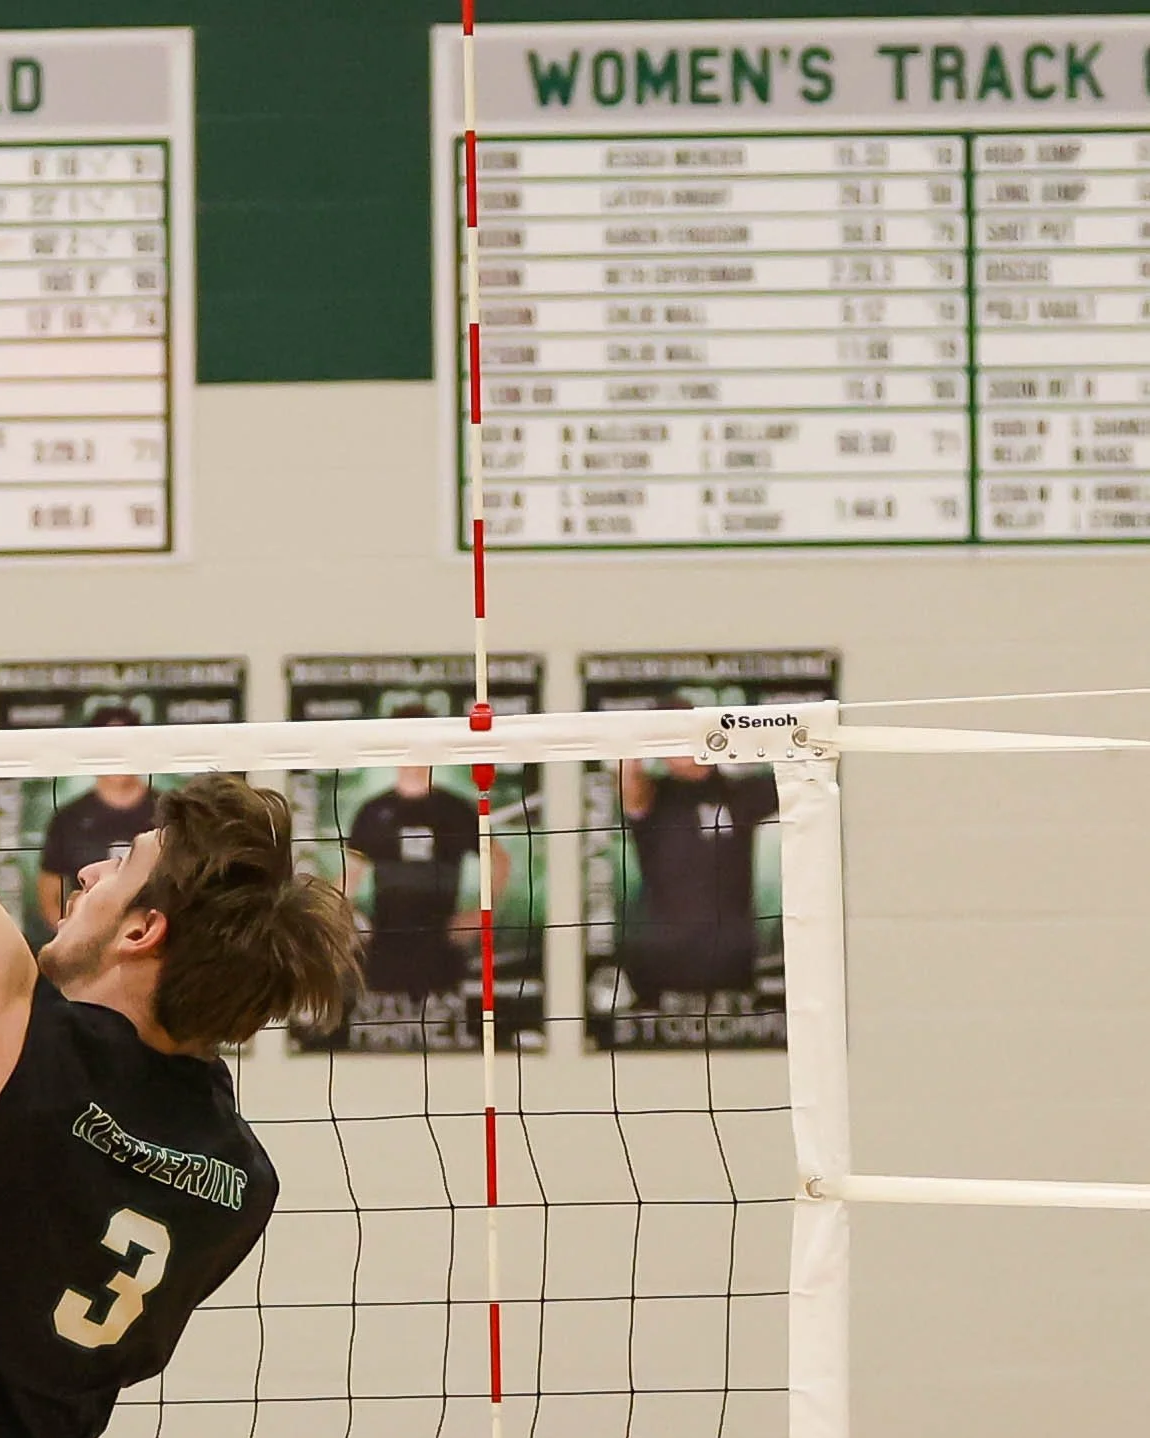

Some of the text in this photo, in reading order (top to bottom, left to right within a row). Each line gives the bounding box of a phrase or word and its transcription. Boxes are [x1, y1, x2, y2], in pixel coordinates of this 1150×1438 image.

[527, 46, 836, 107] WOMEN'S
[876, 41, 1105, 102] TRACK
[737, 713, 798, 729] Senoh
[72, 1101, 249, 1212] KETTERING
[53, 1207, 171, 1349] 3
